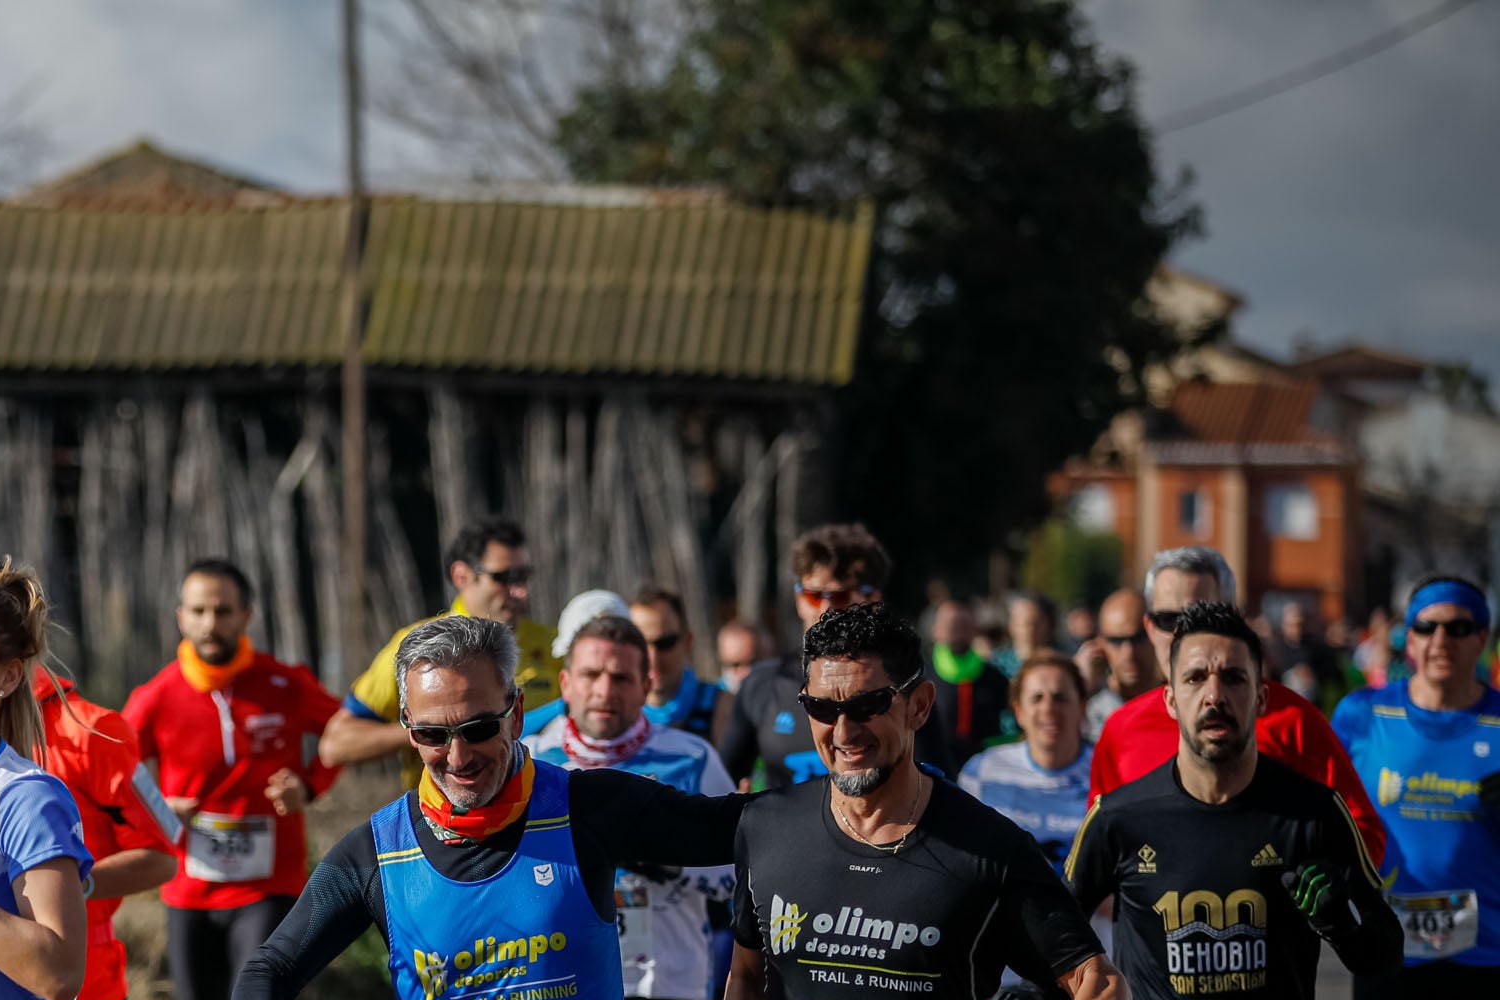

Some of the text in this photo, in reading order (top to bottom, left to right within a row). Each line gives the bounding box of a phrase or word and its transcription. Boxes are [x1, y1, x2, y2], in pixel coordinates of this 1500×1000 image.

[849, 864, 875, 873] CRAFT
[1152, 889, 1267, 933] 100
[813, 906, 941, 950] olimpo
[454, 932, 567, 970] olimpo
[805, 937, 886, 960] deportes
[1167, 939, 1267, 974] BEHOBIA
[454, 964, 527, 989] deportes
[809, 970, 933, 992] TRAIL & RUNNING
[1169, 974, 1195, 995] SAN
